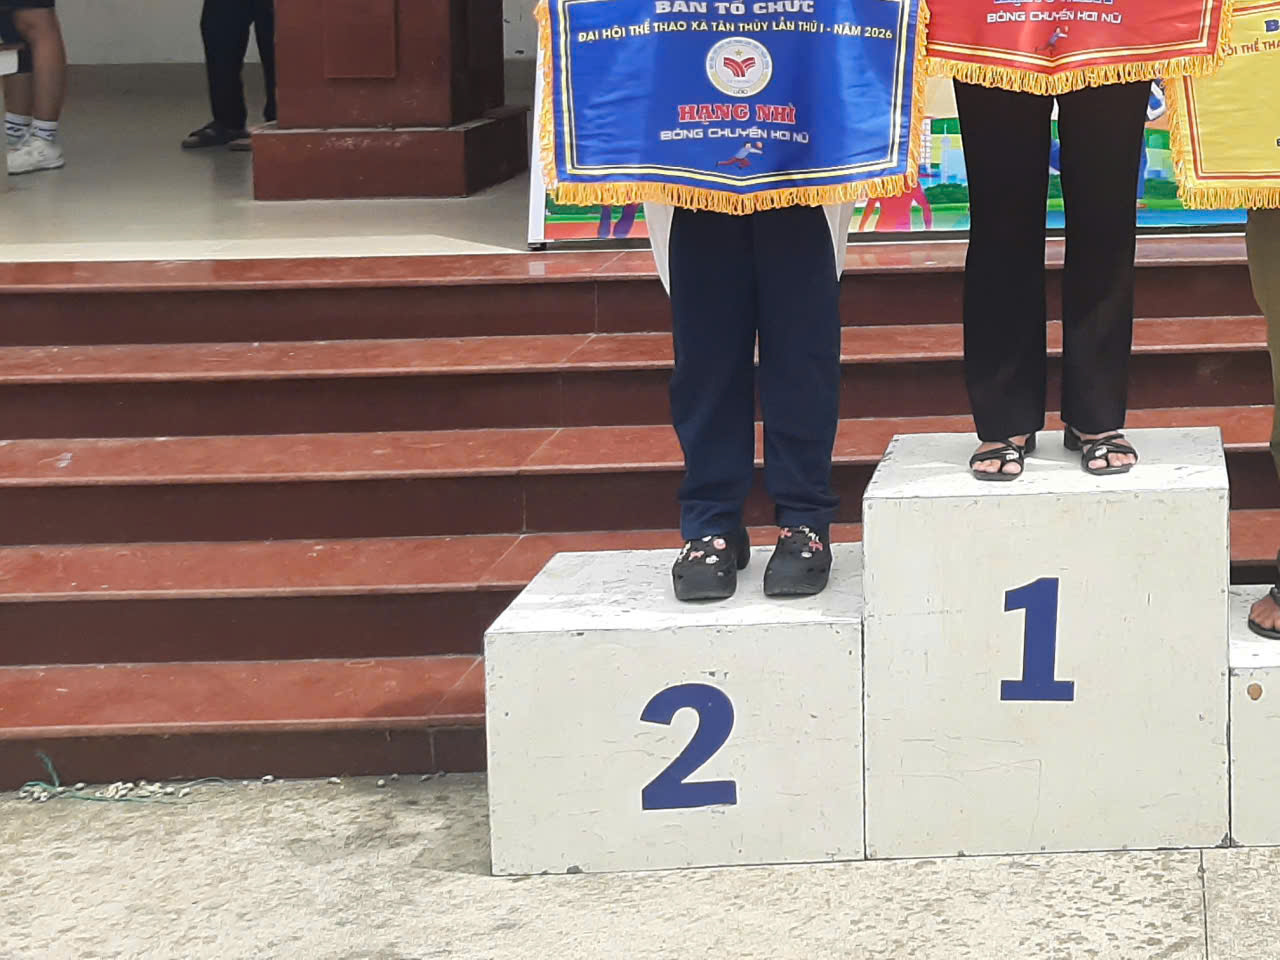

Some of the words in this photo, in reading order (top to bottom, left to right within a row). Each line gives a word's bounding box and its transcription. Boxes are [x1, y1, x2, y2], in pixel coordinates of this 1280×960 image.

[655, 0, 707, 14] BAN
[987, 10, 1026, 23] BÓNG
[578, 31, 598, 43] ĐẠI
[602, 25, 626, 41] HỘI
[629, 18, 650, 36] THỂ
[653, 21, 686, 32] THAO
[691, 19, 708, 31] XÃ
[711, 20, 734, 31] TÂN
[833, 22, 861, 36] NĂM
[864, 27, 892, 38] 2026
[678, 104, 749, 125] HẠNG
[756, 102, 796, 124] NHÌ
[660, 128, 703, 140] BÓNG
[999, 577, 1074, 701] 1
[640, 683, 738, 811] 2
